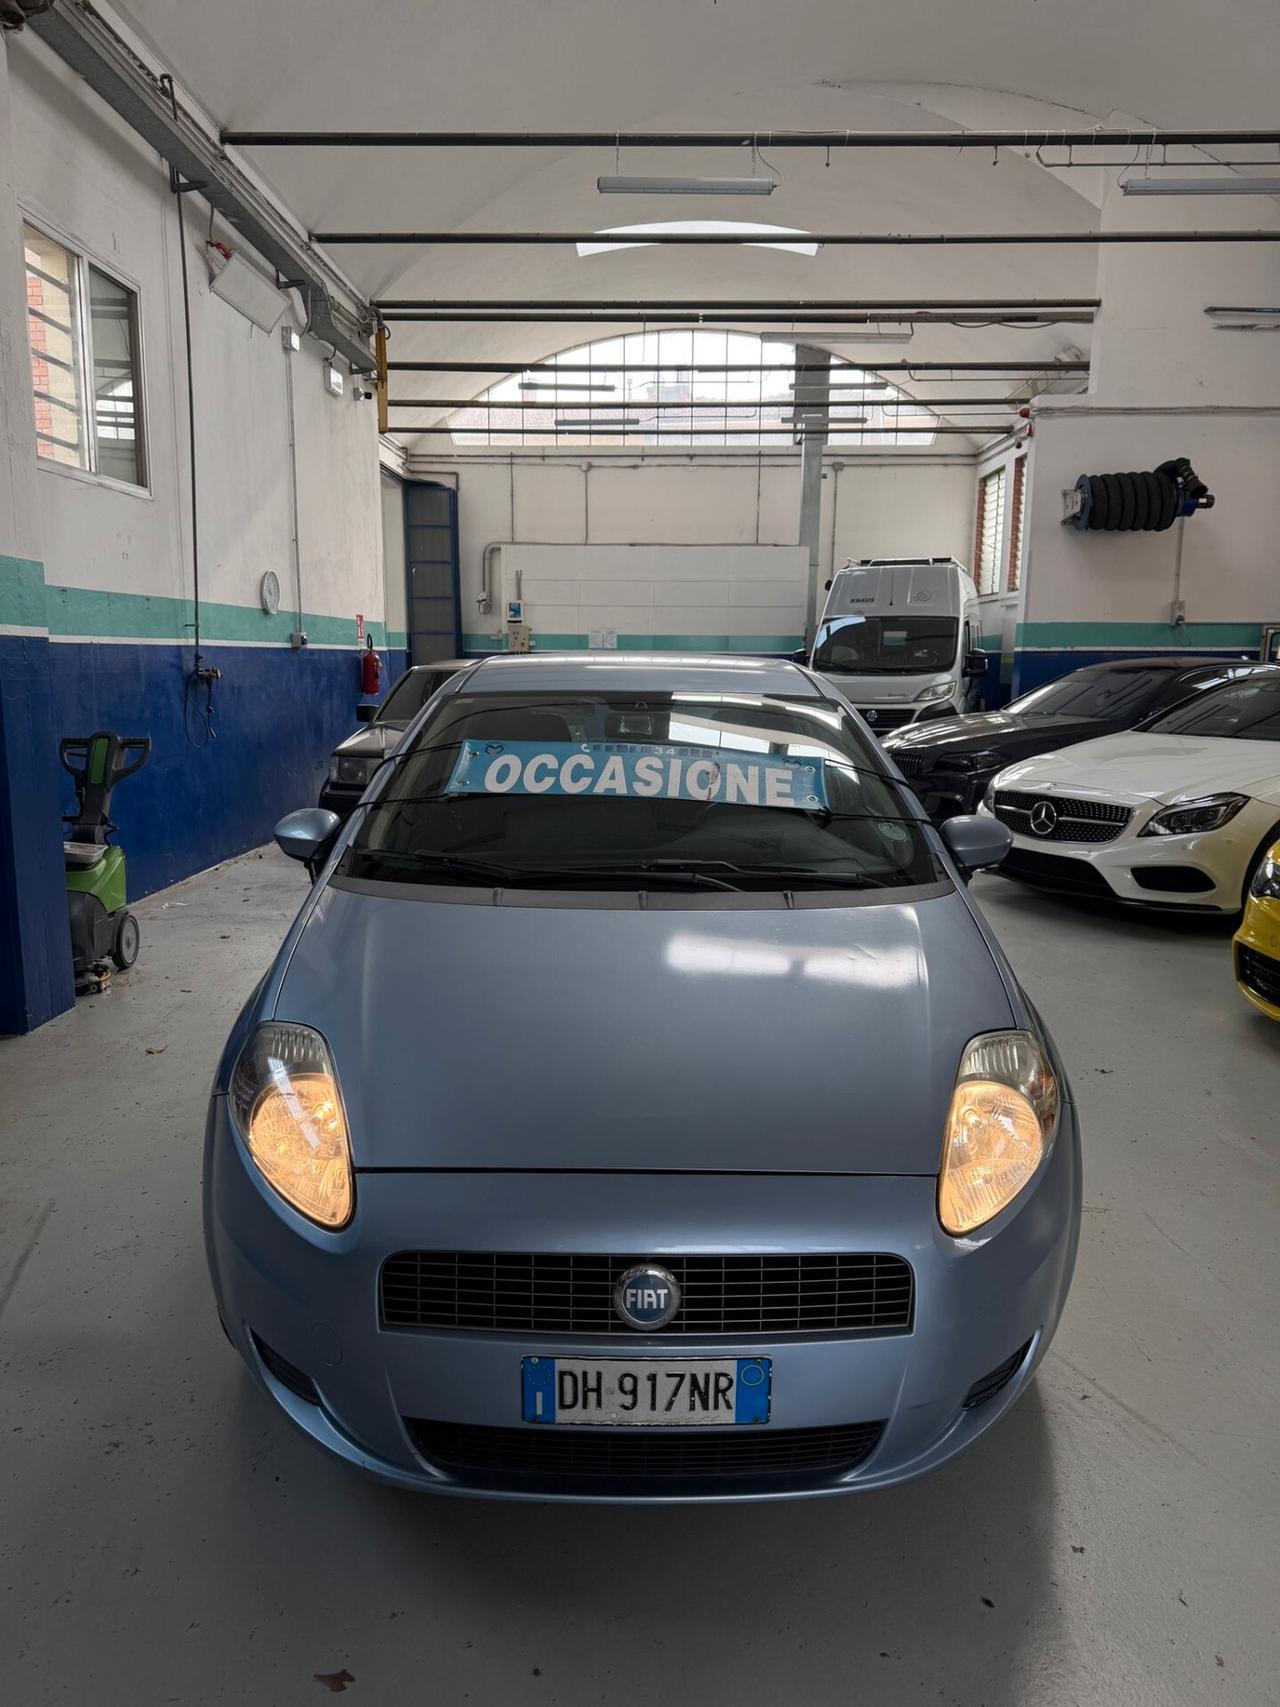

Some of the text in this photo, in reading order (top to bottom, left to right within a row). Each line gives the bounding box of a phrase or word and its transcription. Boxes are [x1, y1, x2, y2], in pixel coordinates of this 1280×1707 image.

[483, 753, 796, 807] OCCASIONE
[625, 1288, 669, 1310] FIAT
[558, 1370, 602, 1410] DH
[618, 1371, 734, 1412] 917NR
